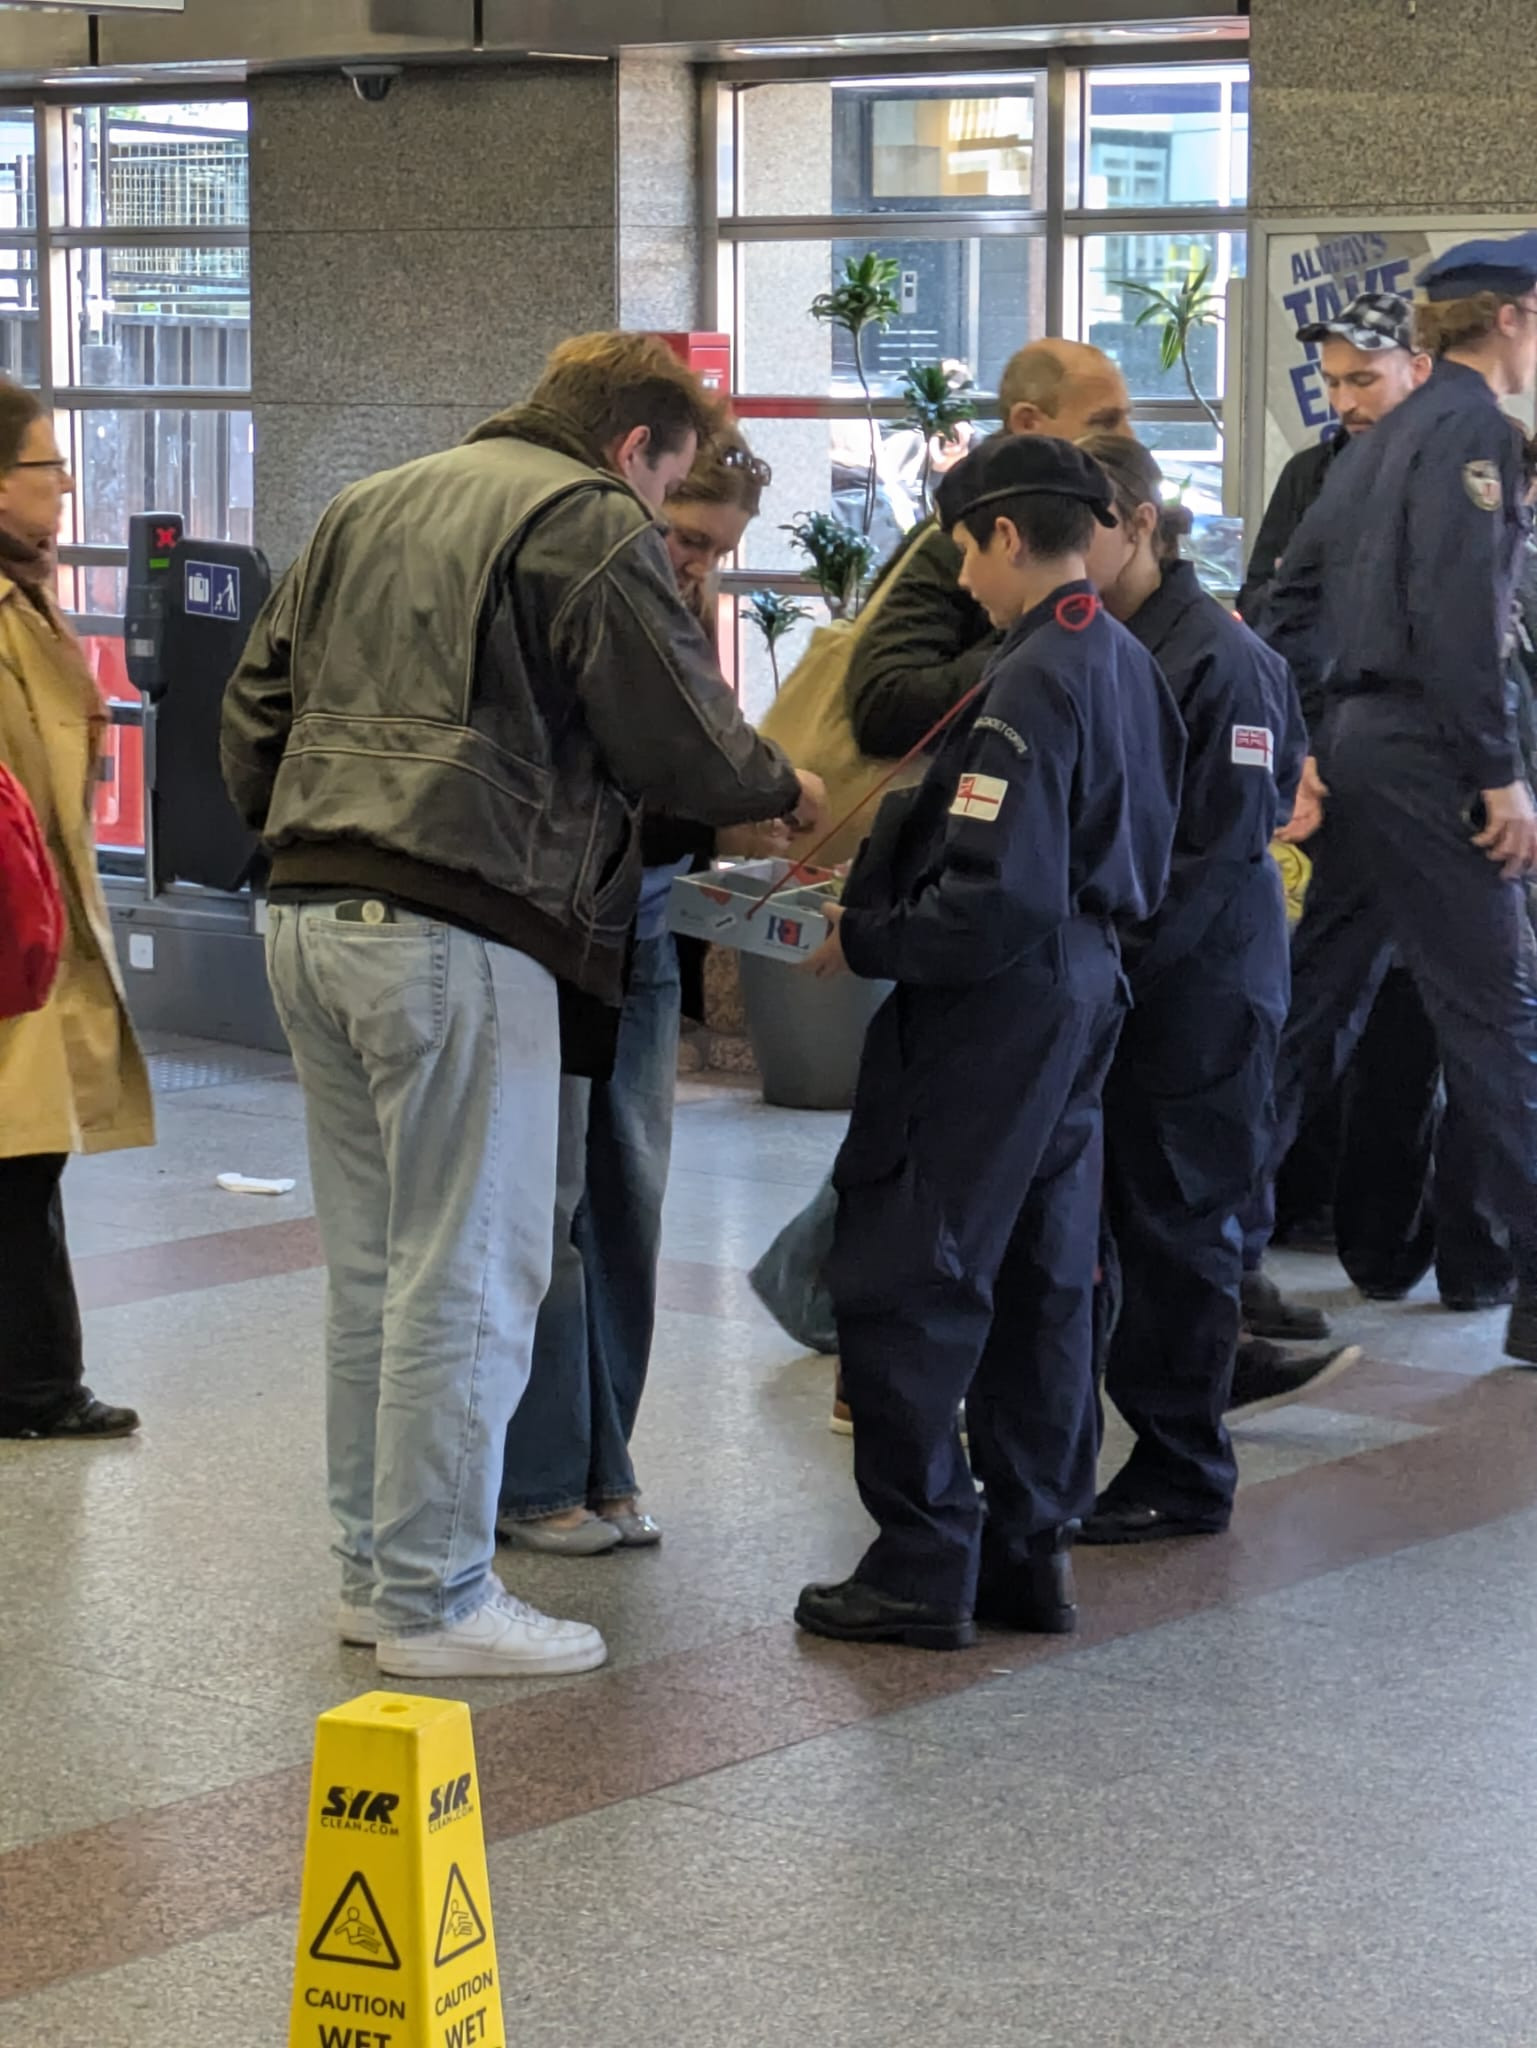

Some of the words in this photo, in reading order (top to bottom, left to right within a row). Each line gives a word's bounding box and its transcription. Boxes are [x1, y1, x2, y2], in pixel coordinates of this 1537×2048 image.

[1291, 233, 1387, 284] ALWAYS
[321, 1786, 399, 1824] SIR
[428, 1772, 471, 1822] SIR
[321, 1817, 399, 1835] CLEAN.COM
[305, 1988, 405, 2019] CAUTION
[435, 1969, 493, 2016] CAUTION
[445, 2006, 487, 2048] WET
